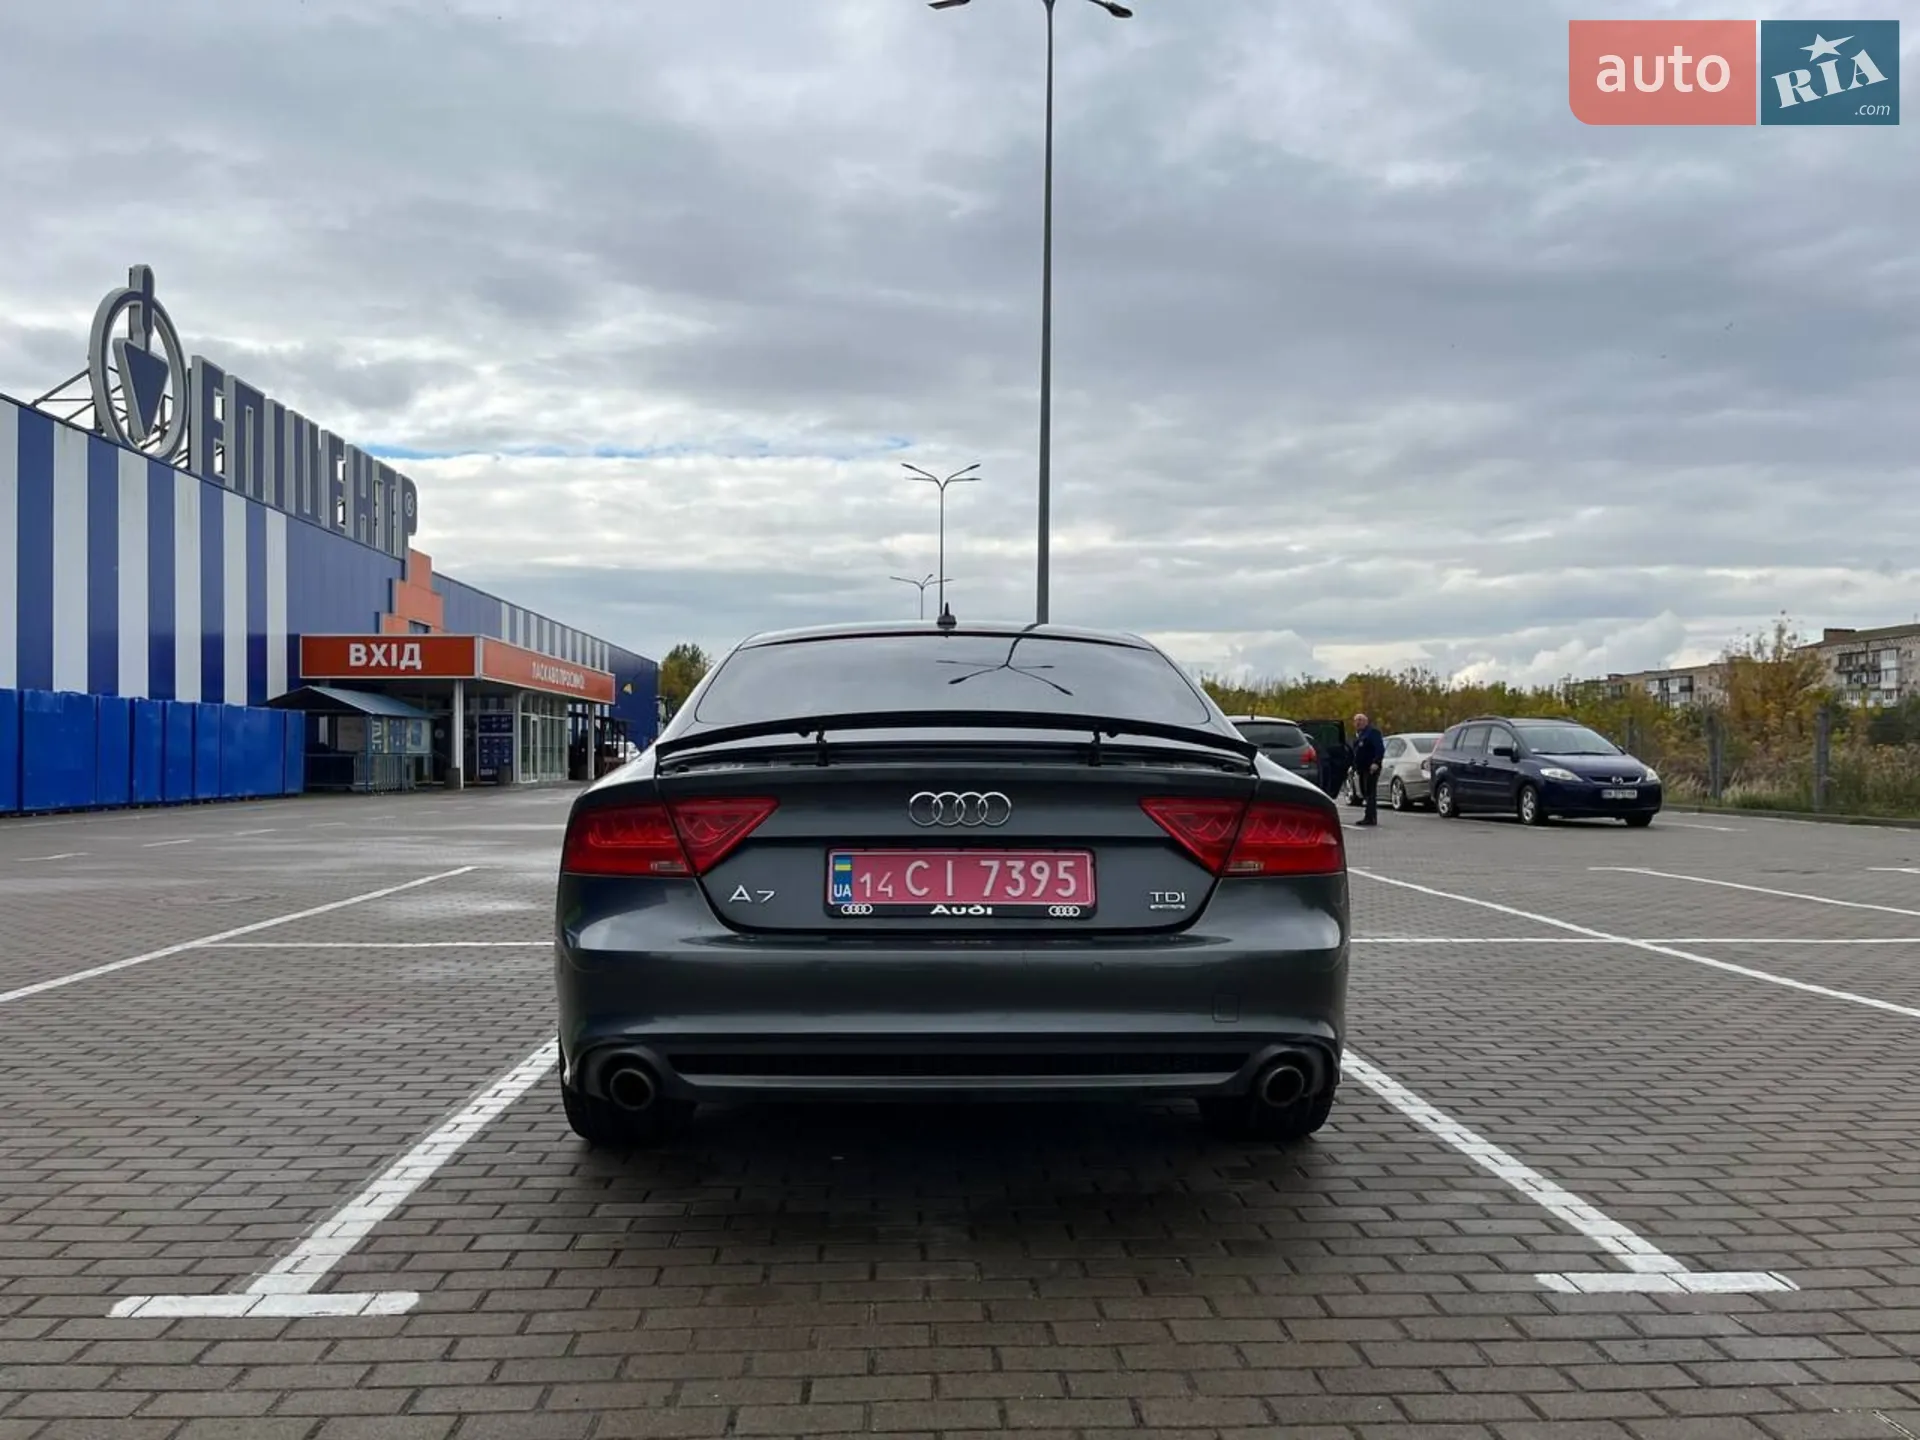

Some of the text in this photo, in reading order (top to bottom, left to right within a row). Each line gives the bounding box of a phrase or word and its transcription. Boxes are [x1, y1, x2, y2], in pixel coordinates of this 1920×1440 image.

[349, 643, 422, 670] ВХІД
[833, 883, 852, 897] UA
[859, 871, 894, 898] 14
[979, 859, 1077, 897] 7395
[1149, 891, 1185, 902] TDI
[930, 904, 992, 916] Audi
